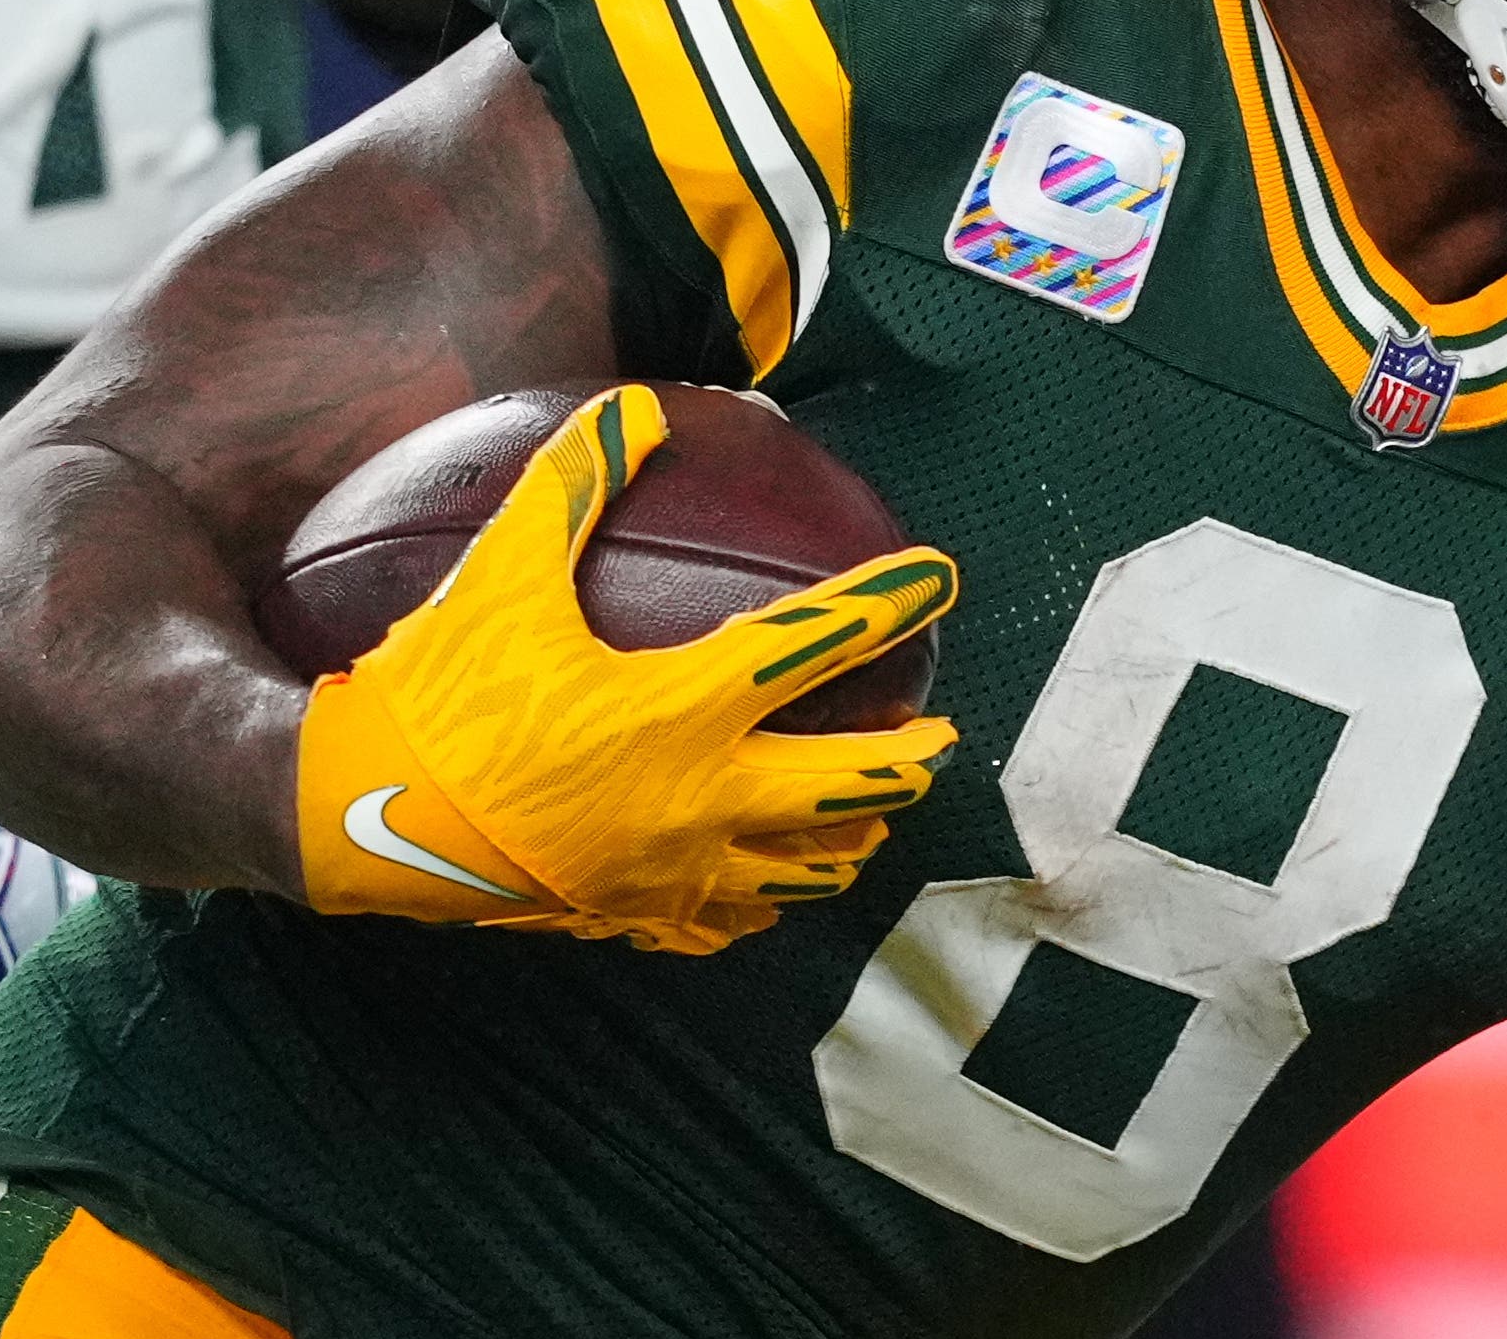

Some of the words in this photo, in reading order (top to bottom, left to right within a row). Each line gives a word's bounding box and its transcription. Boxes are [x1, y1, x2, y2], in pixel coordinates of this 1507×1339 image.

[989, 97, 1164, 262] C
[1366, 376, 1432, 435] NFL
[812, 517, 1487, 1262] 8
